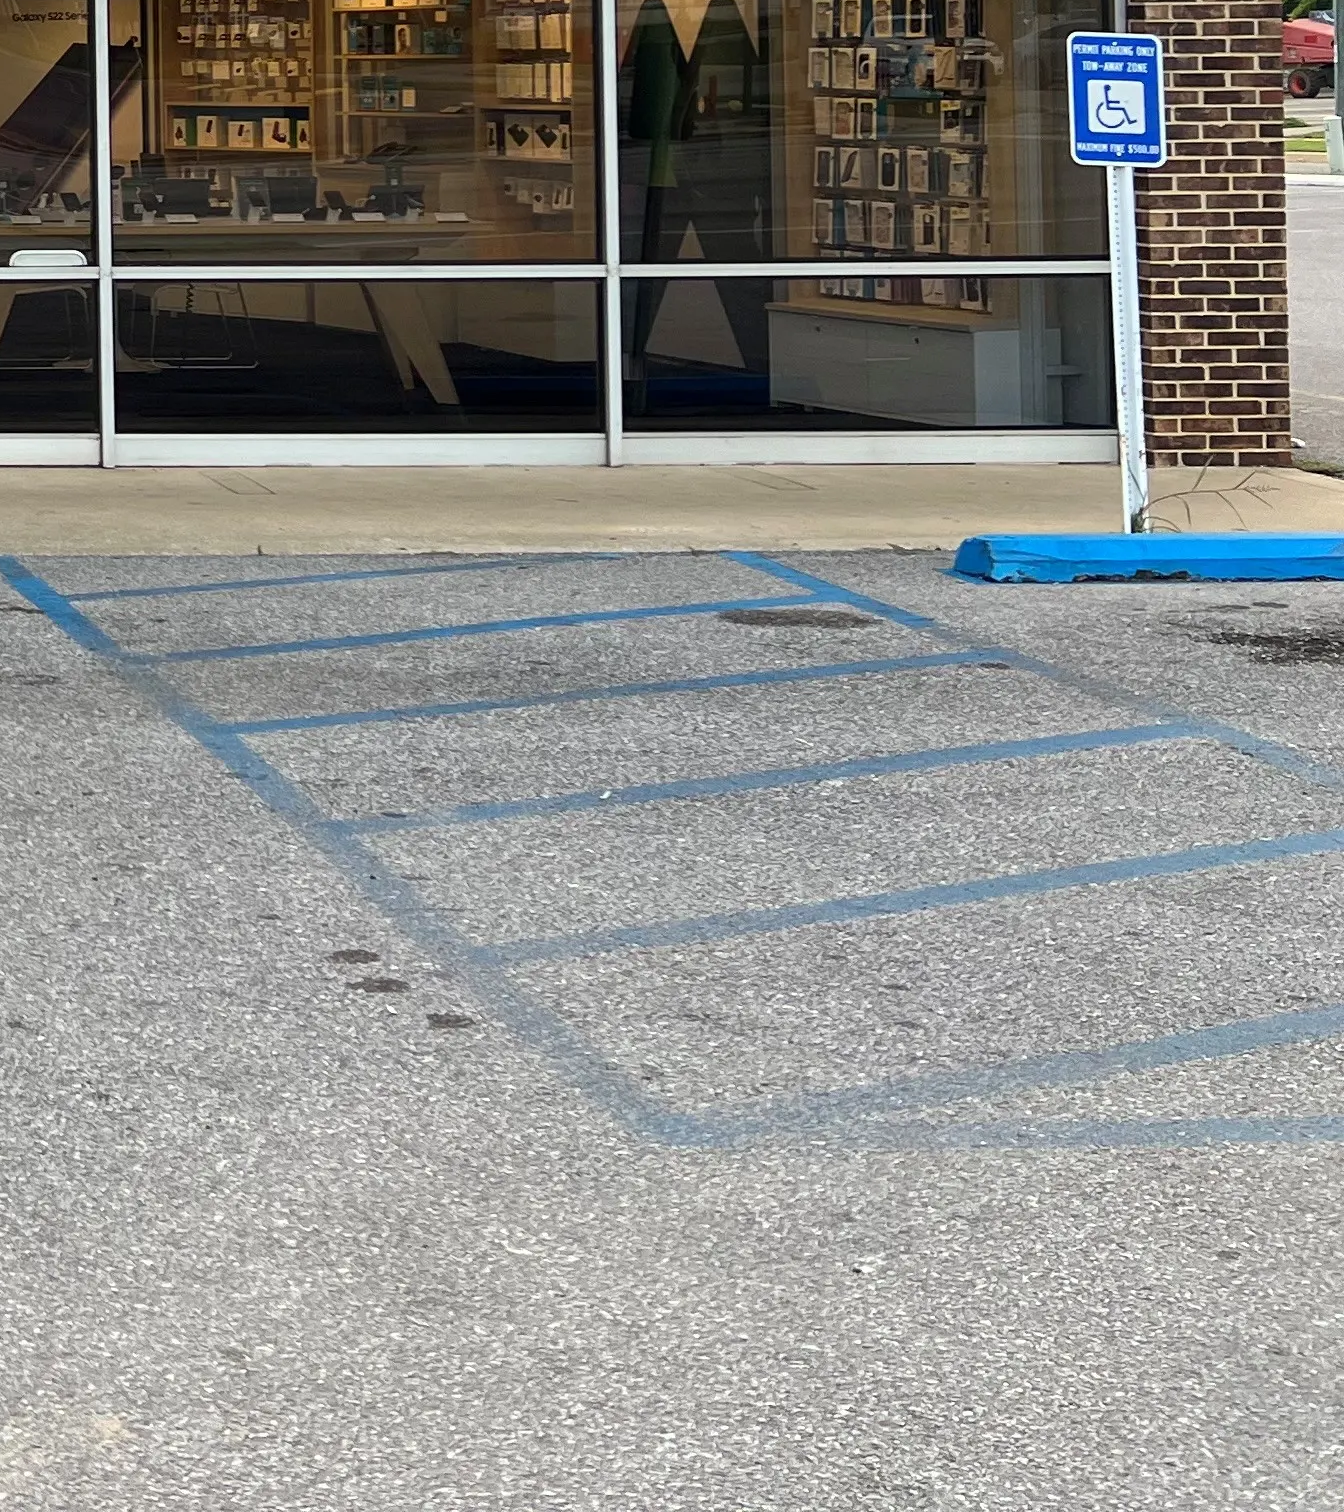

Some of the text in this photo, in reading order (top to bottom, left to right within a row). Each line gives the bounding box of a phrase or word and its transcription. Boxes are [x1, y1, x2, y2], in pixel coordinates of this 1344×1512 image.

[13, 11, 89, 24] Galaxy S22 Serie
[1101, 45, 1134, 56] PARKING
[1136, 46, 1156, 57] ONLY
[1081, 60, 1148, 73] TOW-AWAY ZONE
[1110, 143, 1126, 153] FINE
